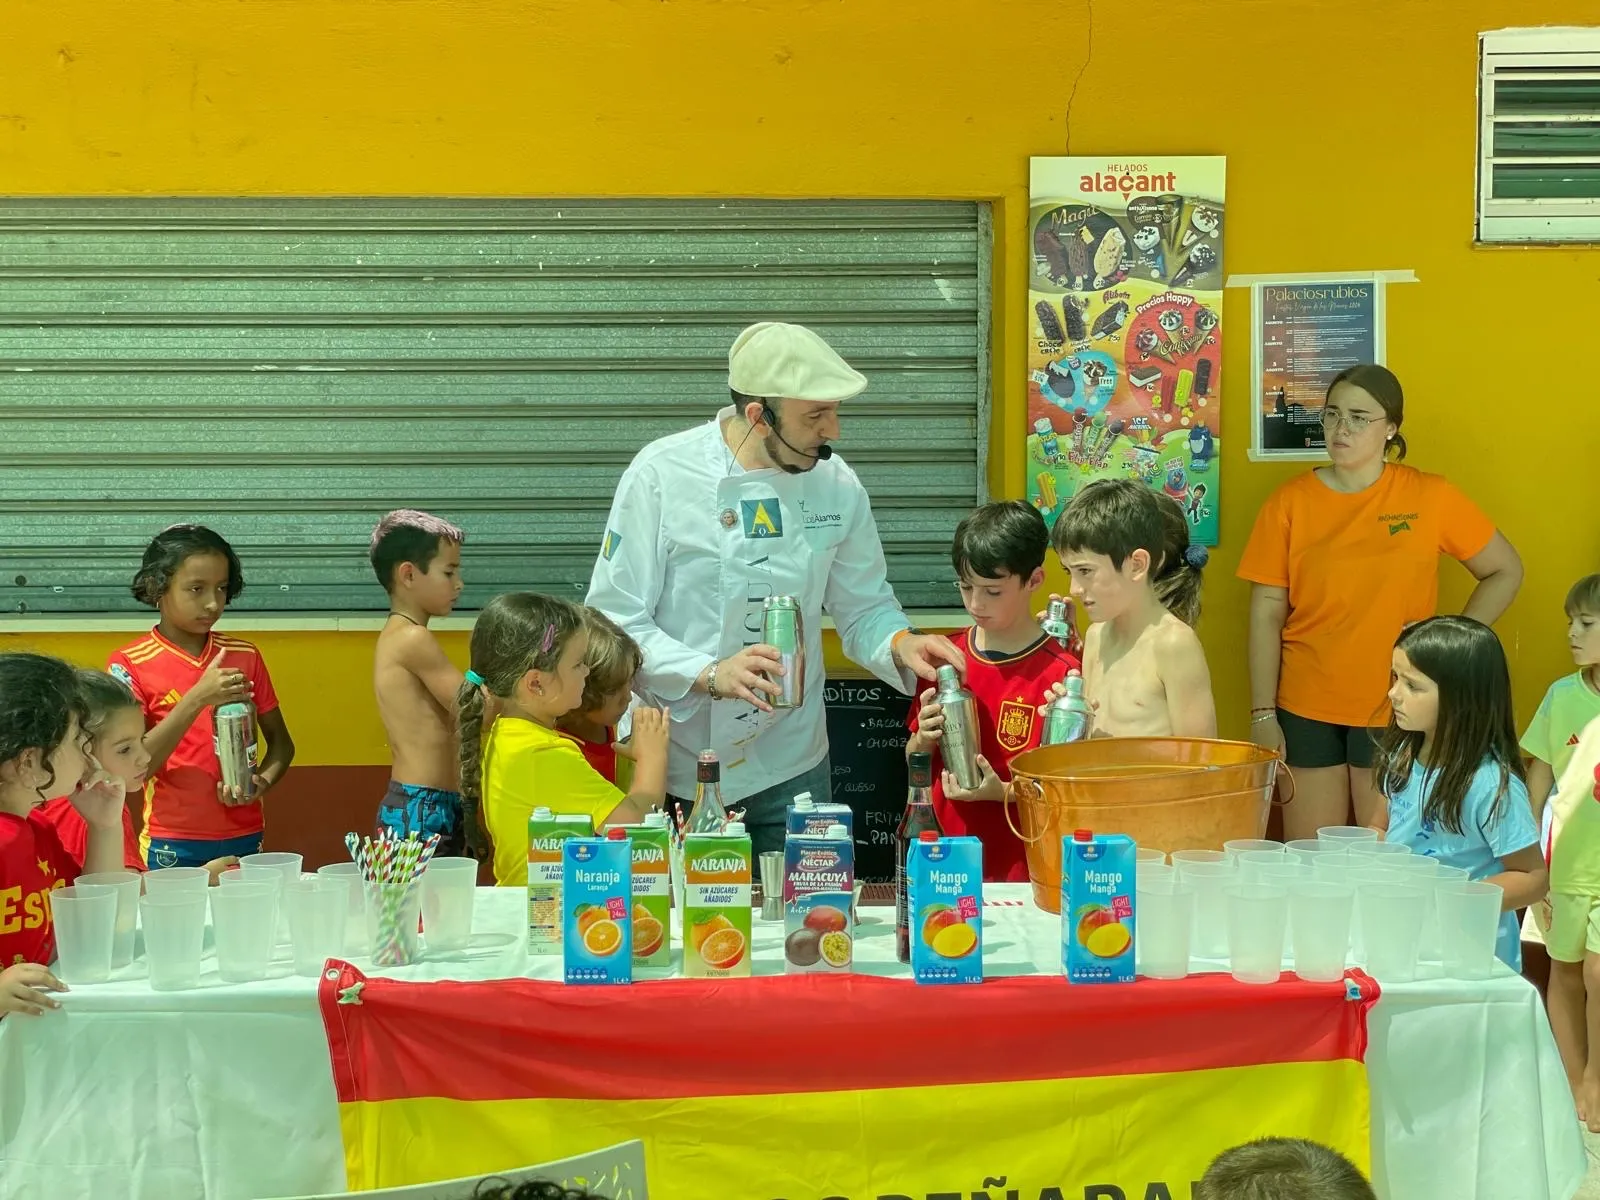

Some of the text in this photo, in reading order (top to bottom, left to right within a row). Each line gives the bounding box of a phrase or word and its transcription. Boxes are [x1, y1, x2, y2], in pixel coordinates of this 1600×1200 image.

[1107, 164, 1148, 172] HELADOS
[1266, 285, 1368, 301] Palaciosrubios
[1137, 292, 1193, 313] Precios Happy
[691, 858, 746, 873] NARANJA
[575, 869, 620, 885] Naranja
[788, 871, 848, 882] MARACUYÁ
[930, 870, 968, 887] Mango
[1085, 870, 1122, 887] Mango
[588, 884, 609, 892] Laranja
[710, 886, 738, 894] AZÚCARES
[936, 883, 963, 895] Manga
[1090, 883, 1117, 895] Manga
[704, 895, 732, 903] AÑADIDOS
